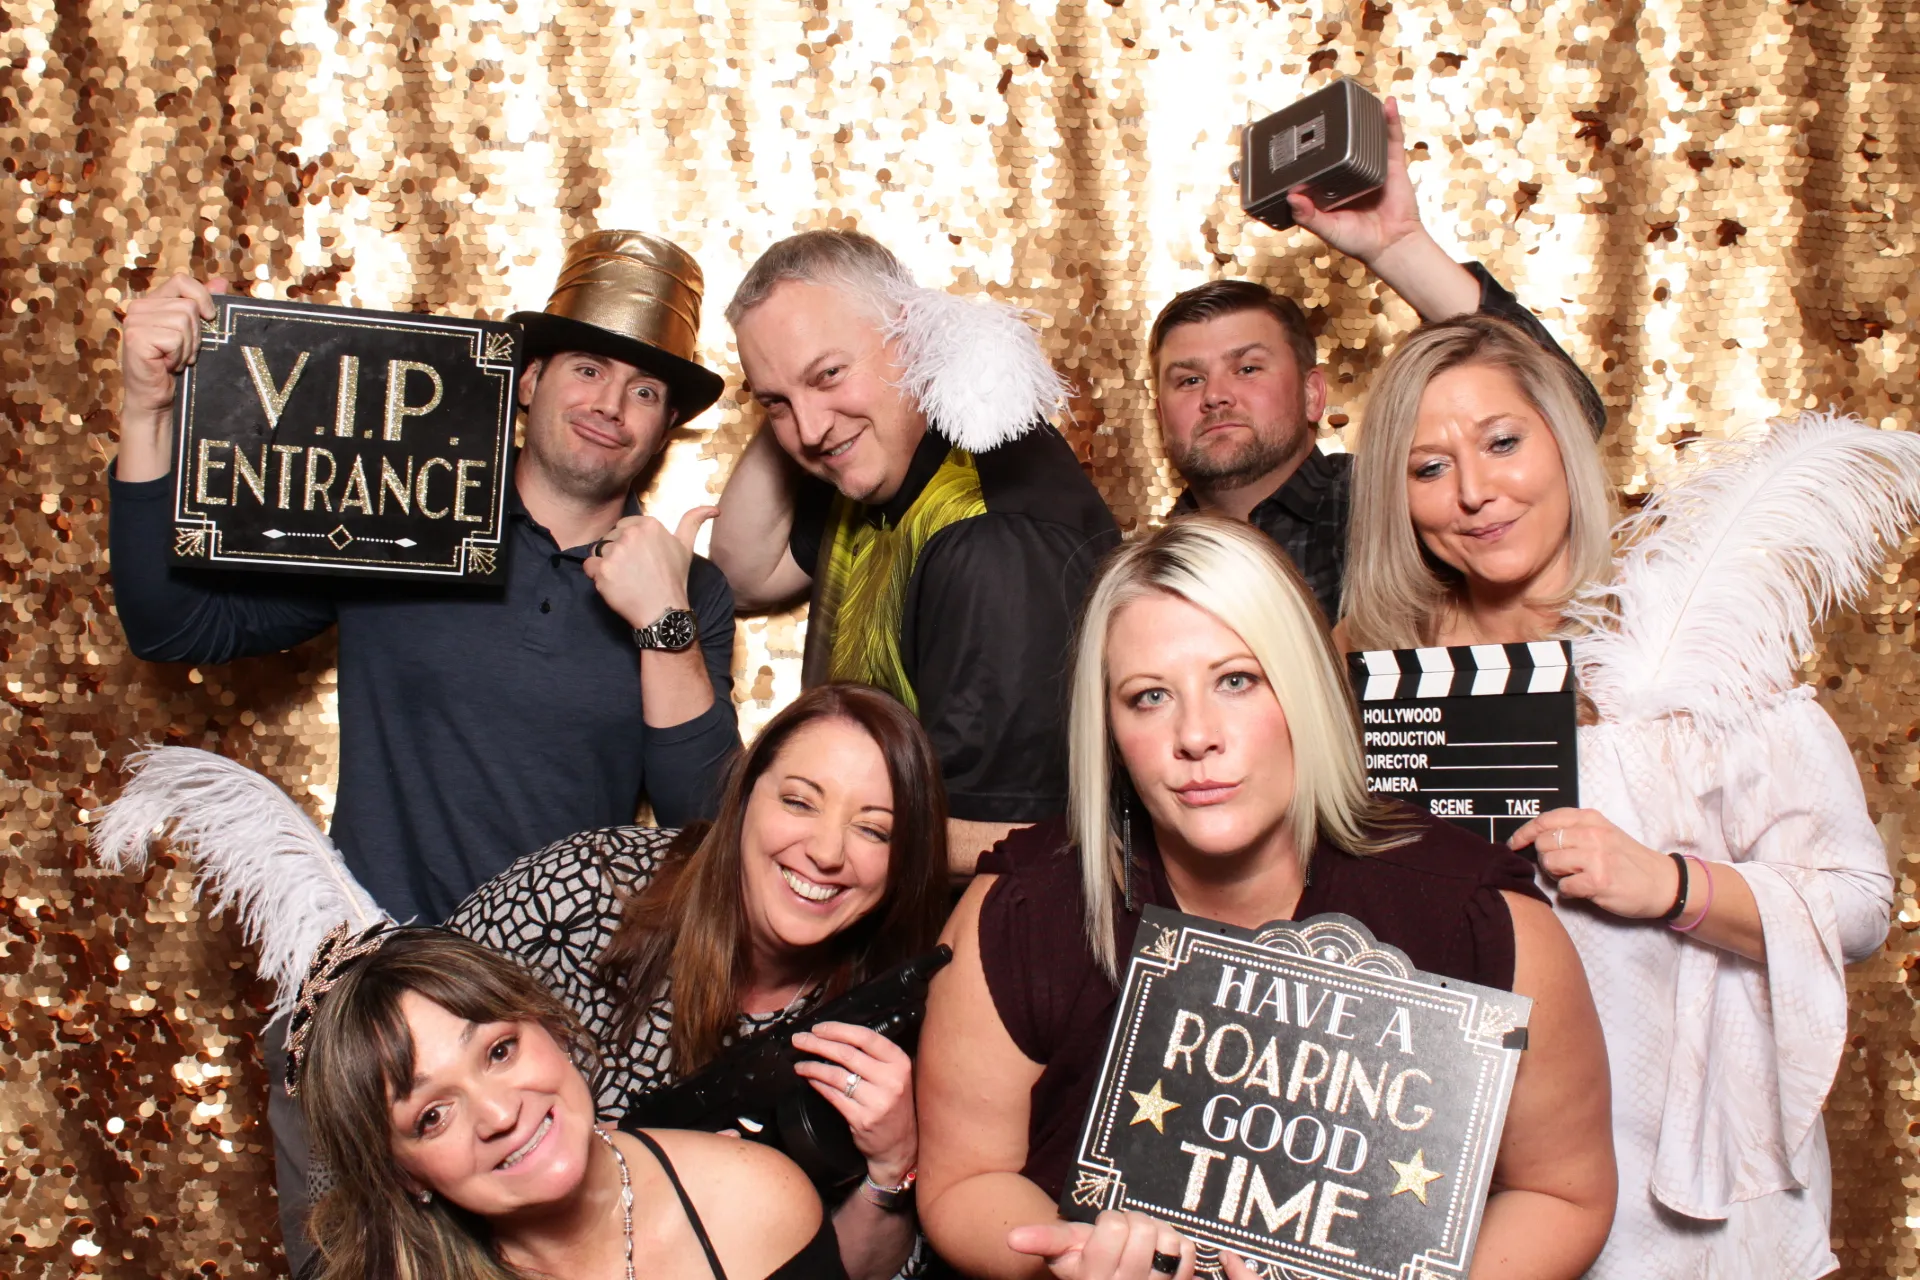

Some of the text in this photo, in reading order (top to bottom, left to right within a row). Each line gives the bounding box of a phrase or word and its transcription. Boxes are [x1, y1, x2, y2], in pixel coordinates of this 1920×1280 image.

[240, 345, 460, 446] V.I.P.
[196, 438, 487, 522] ENTRANCE
[1363, 707, 1442, 724] HOLLYWOOD
[1364, 731, 1446, 747] PRODUCTION
[1365, 754, 1428, 769] DIRECTOR
[1366, 777, 1418, 792] CAMERA
[1430, 799, 1541, 815] SCENE TAKE
[1212, 965, 1415, 1055] HAVE A
[1162, 1009, 1433, 1132] ROARING
[1201, 1093, 1369, 1176] GOOD
[1179, 1140, 1370, 1258] TIME
